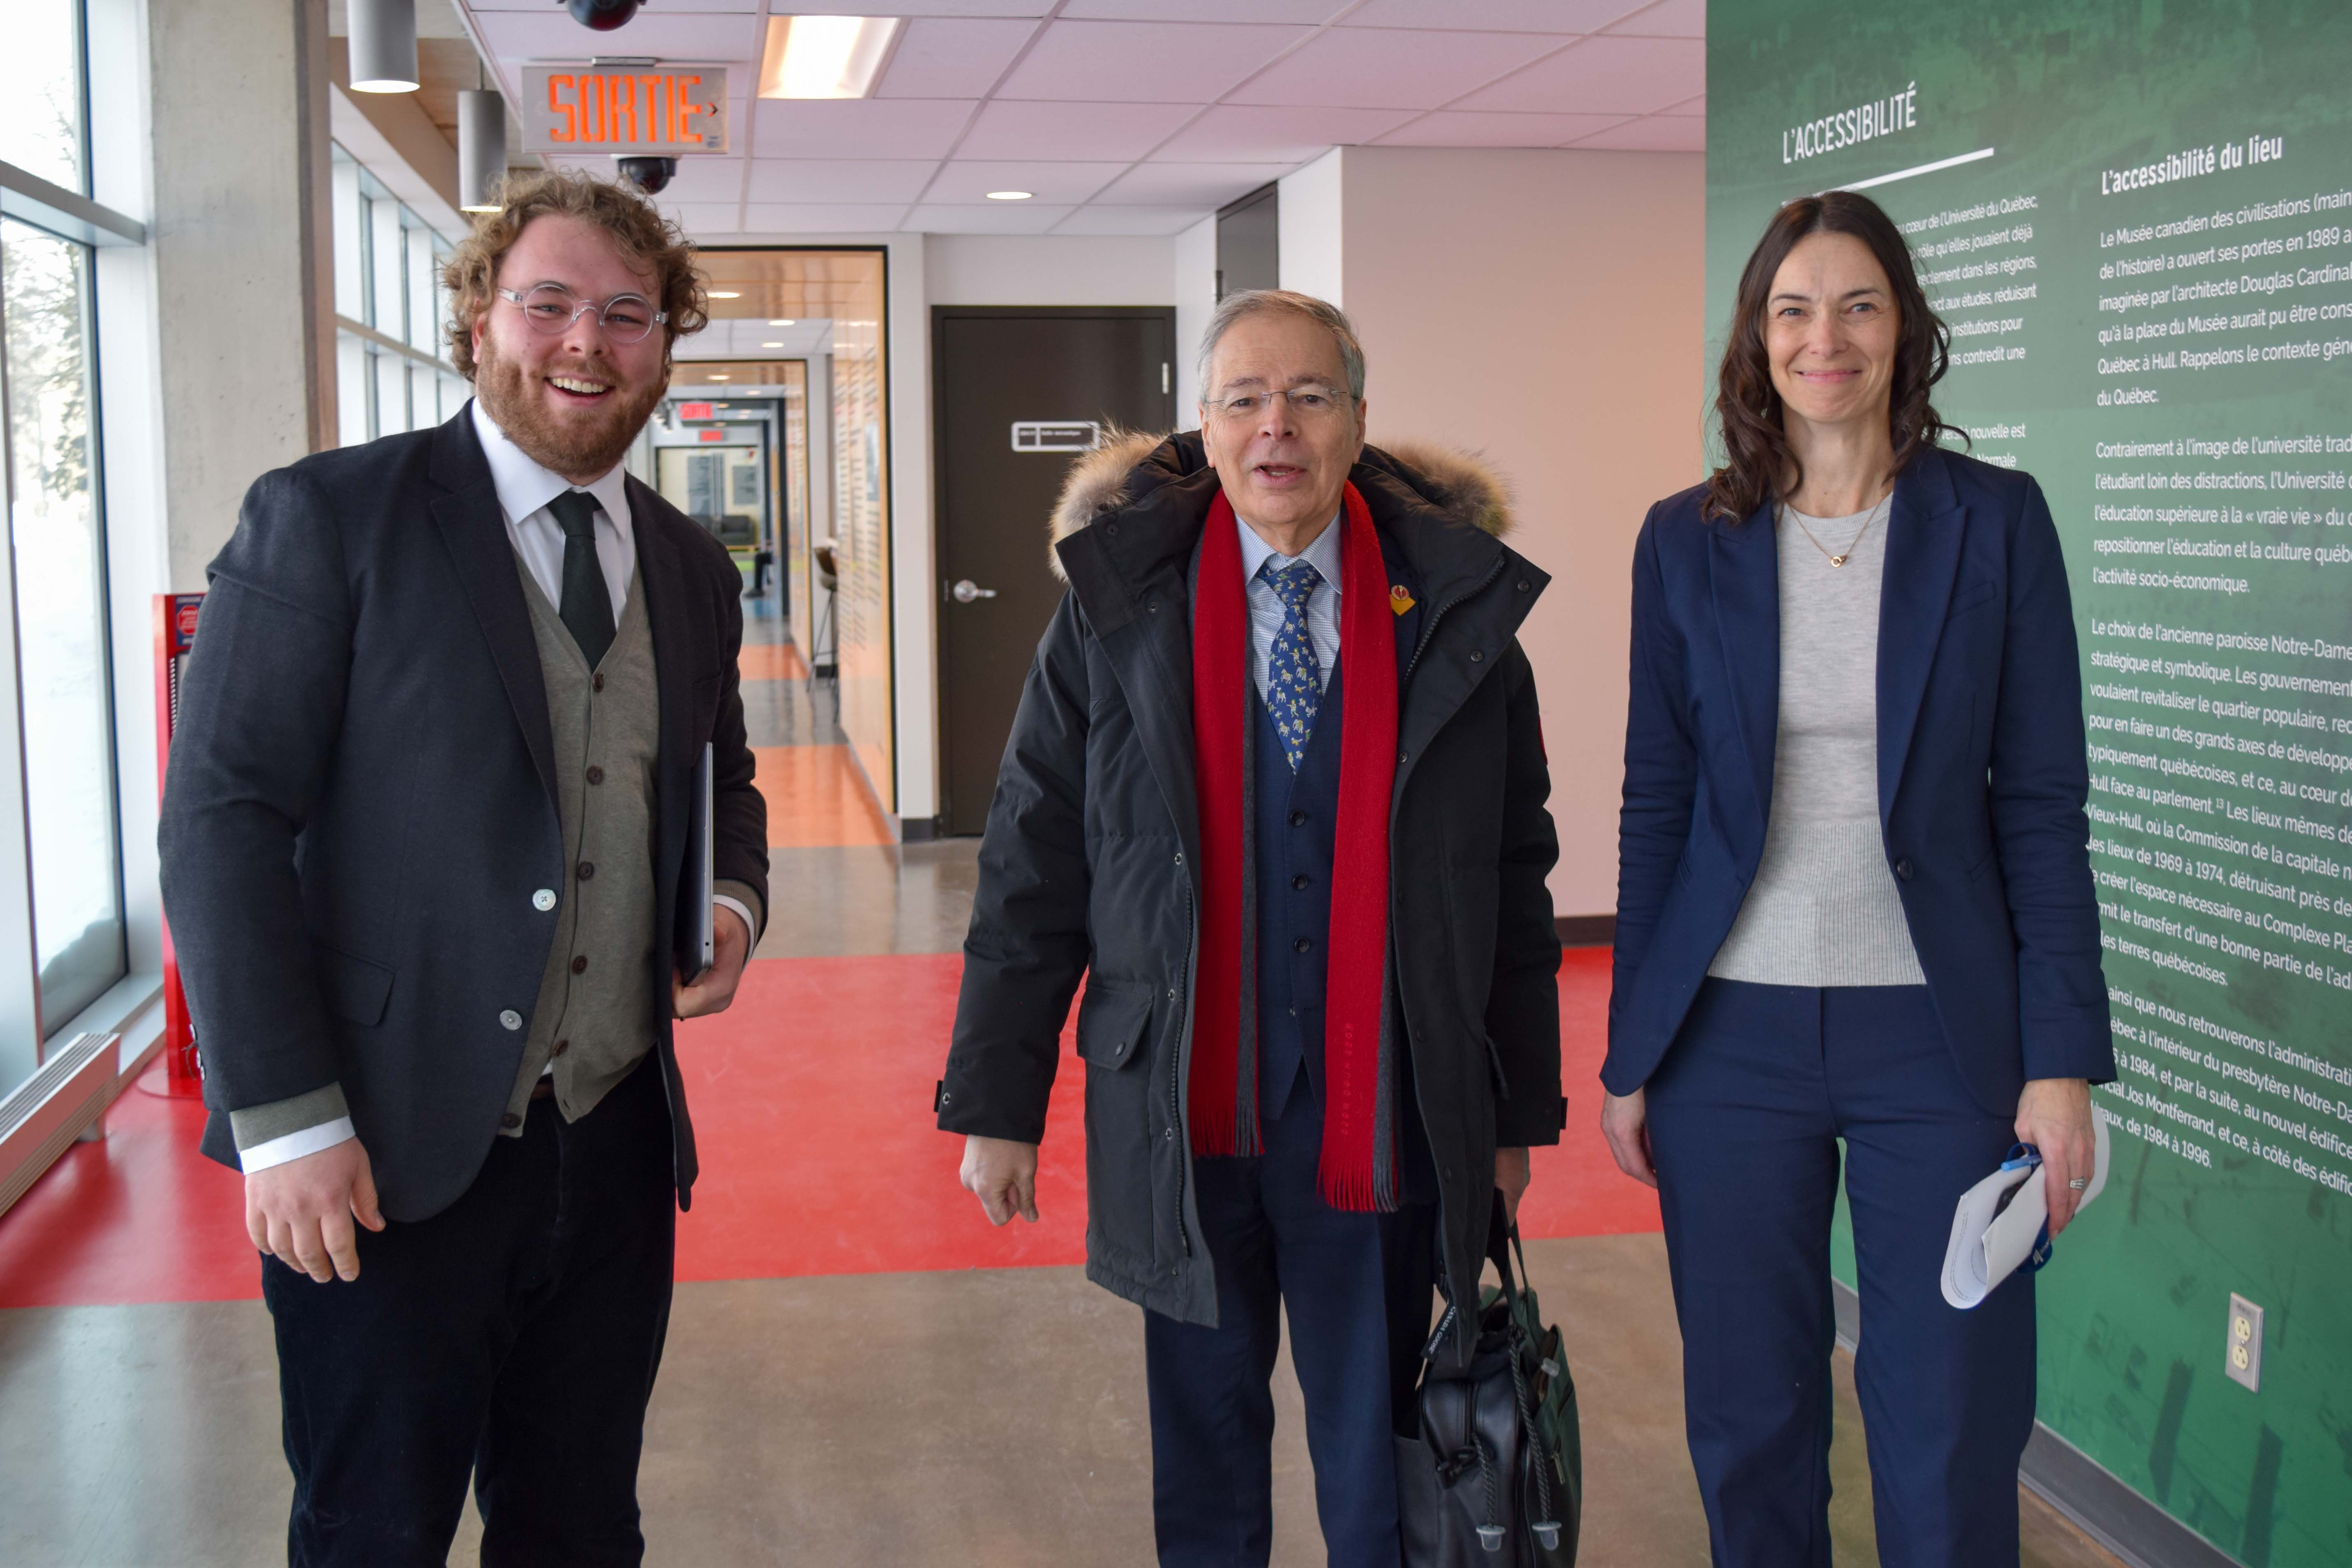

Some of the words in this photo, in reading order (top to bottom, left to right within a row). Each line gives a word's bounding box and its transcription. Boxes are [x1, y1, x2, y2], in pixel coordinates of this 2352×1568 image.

[548, 74, 702, 142] SORTIE
[1783, 81, 1917, 163] L'ACCESSIBILITÉ
[2101, 145, 2215, 195] L'accessibilité
[2220, 143, 2243, 170] du
[2249, 135, 2282, 164] lieu
[1905, 219, 1928, 234] cœur
[1927, 214, 1940, 229] de
[1940, 204, 1986, 226] l'Université
[1986, 202, 1999, 217] du
[1999, 195, 2038, 214] Québec,
[2100, 232, 2115, 248] Le
[2116, 225, 2154, 245] Musée
[2155, 216, 2208, 238] canadien
[2210, 211, 2234, 228] des
[2236, 199, 2310, 224] civilisations
[1917, 243, 1935, 258] rôle
[1936, 237, 1972, 258] qu'elles
[1971, 228, 2010, 252] jouaient
[2011, 223, 2033, 243] déjà
[2116, 254, 2165, 277] l'histoire)
[2177, 247, 2215, 267] ouvert
[2217, 246, 2239, 262] ses
[2241, 239, 2283, 262] portes
[2286, 237, 2303, 251] en
[2306, 227, 2340, 249] 1989
[1961, 264, 1984, 279] dans
[1985, 261, 1999, 275] les
[2000, 256, 2037, 275] régions,
[1945, 297, 1961, 309] aux
[1961, 290, 1993, 307] études,
[1994, 283, 2037, 303] réduisant
[2099, 290, 2149, 313] imaginée
[2151, 290, 2170, 309] par
[2172, 279, 2238, 302] l'architecte
[2240, 272, 2294, 295] Douglas
[1952, 319, 1999, 337] institutions
[2000, 318, 2023, 335] pour
[2098, 325, 2122, 346] qu'à
[2136, 322, 2167, 343] place
[2187, 314, 2228, 333] Musée
[2230, 309, 2266, 329] aurait
[2269, 311, 2286, 329] pu
[2289, 305, 2317, 323] être
[1962, 346, 2005, 364] contredit
[2006, 347, 2026, 360] une
[2097, 357, 2140, 374] Québec
[2152, 352, 2177, 369] Hull.
[2180, 348, 2244, 370] Rappelons
[2247, 345, 2259, 362] le
[2261, 341, 2320, 360] contexte
[2097, 390, 2111, 406] du
[2113, 388, 2159, 405] Québec.
[1970, 423, 2010, 439] nouvelle
[2010, 423, 2026, 438] est
[2096, 440, 2174, 458] Contrairement
[2186, 439, 2230, 459] l'image
[2252, 435, 2322, 454] l'université
[2095, 473, 2145, 489] l'étudiant
[2147, 473, 2168, 489] loin
[2170, 472, 2192, 489] des
[2194, 472, 2267, 490] distractions,
[2271, 471, 2345, 489] l'Université
[2094, 504, 2154, 521] l'éducation
[2156, 506, 2219, 526] supérieure
[2256, 507, 2288, 524] vraie
[2291, 507, 2310, 525] vie
[2094, 537, 2165, 556] repositionner
[2167, 538, 2231, 557] l'éducation
[2264, 542, 2312, 560] culture
[2093, 567, 2137, 585] l'activité
[2139, 570, 2250, 596] socio-économique.
[2092, 618, 2106, 635] Le
[2107, 620, 2136, 638] choix
[2138, 623, 2154, 639] de
[2155, 624, 2214, 646] l'ancienne
[2216, 632, 2268, 651] paroisse
[2091, 650, 2150, 674] stratégique
[2164, 660, 2232, 684] symbolique.
[2235, 667, 2257, 685] Les
[2090, 683, 2139, 702] voulaient
[2141, 689, 2196, 710] revitaliser
[2212, 701, 2261, 719] quartier
[2263, 709, 2328, 732] populaire,
[2089, 715, 2114, 730] pour
[2114, 719, 2129, 732] en
[2130, 717, 2154, 737] faire
[2156, 726, 2170, 739] un
[2172, 725, 2193, 743] des
[2194, 732, 2235, 750] grands
[2237, 739, 2266, 755] axes
[2268, 740, 2285, 759] de
[2088, 742, 2157, 770] typiquement
[2160, 758, 2238, 786] québécoises,
[2257, 777, 2276, 793] ce,
[2299, 785, 2338, 803] cœur
[2110, 777, 2135, 797] face
[2152, 790, 2214, 814] parlement.
[2226, 801, 2249, 821] Les
[2251, 806, 2282, 828] lieux
[2285, 816, 2335, 840] mêmes
[2086, 803, 2144, 832] Vieux-Hull,
[2146, 818, 2161, 835] où
[2176, 824, 2249, 855] Commission
[2286, 853, 2340, 877] capitale
[2107, 839, 2134, 860] lieux
[2154, 851, 2182, 873] 1969
[2196, 861, 2226, 885] 1974,
[2229, 871, 2296, 902] détruisant
[2299, 891, 2330, 911] près
[2100, 871, 2129, 890] créer
[2130, 876, 2176, 904] l'espace
[2178, 892, 2243, 922] nécessaire
[2263, 913, 2331, 947] Complexe
[2100, 930, 2116, 950] les
[2118, 936, 2150, 961] terres
[2152, 951, 2228, 985] québécoises.
[2133, 909, 2182, 938] transfert
[2184, 925, 2218, 949] d'une
[2221, 934, 2261, 962] bonne
[2264, 951, 2302, 974] partie
[2305, 961, 2323, 980] de
[2108, 985, 2132, 1007] ainsi
[2134, 997, 2157, 1015] que
[2158, 1006, 2186, 1026] nous
[2189, 1016, 2265, 1055] retrouverons
[2148, 1030, 2202, 1064] l'intérieur
[2203, 1052, 2220, 1071] du
[2222, 1062, 2290, 1098] presbytère
[2130, 1055, 2158, 1082] 1984,
[2174, 1076, 2194, 1094] par
[2209, 1090, 2241, 1115] suite,
[2263, 1111, 2307, 1141] nouvel
[2125, 1088, 2144, 1106] Jos
[2146, 1093, 2216, 1138] Montferrand,
[2232, 1133, 2250, 1152] ce,
[2262, 1145, 2291, 1168] côté
[2293, 1157, 2317, 1180] des
[2126, 1117, 2141, 1136] de
[2143, 1123, 2170, 1149] 1984
[2182, 1141, 2212, 1168] 1996.
